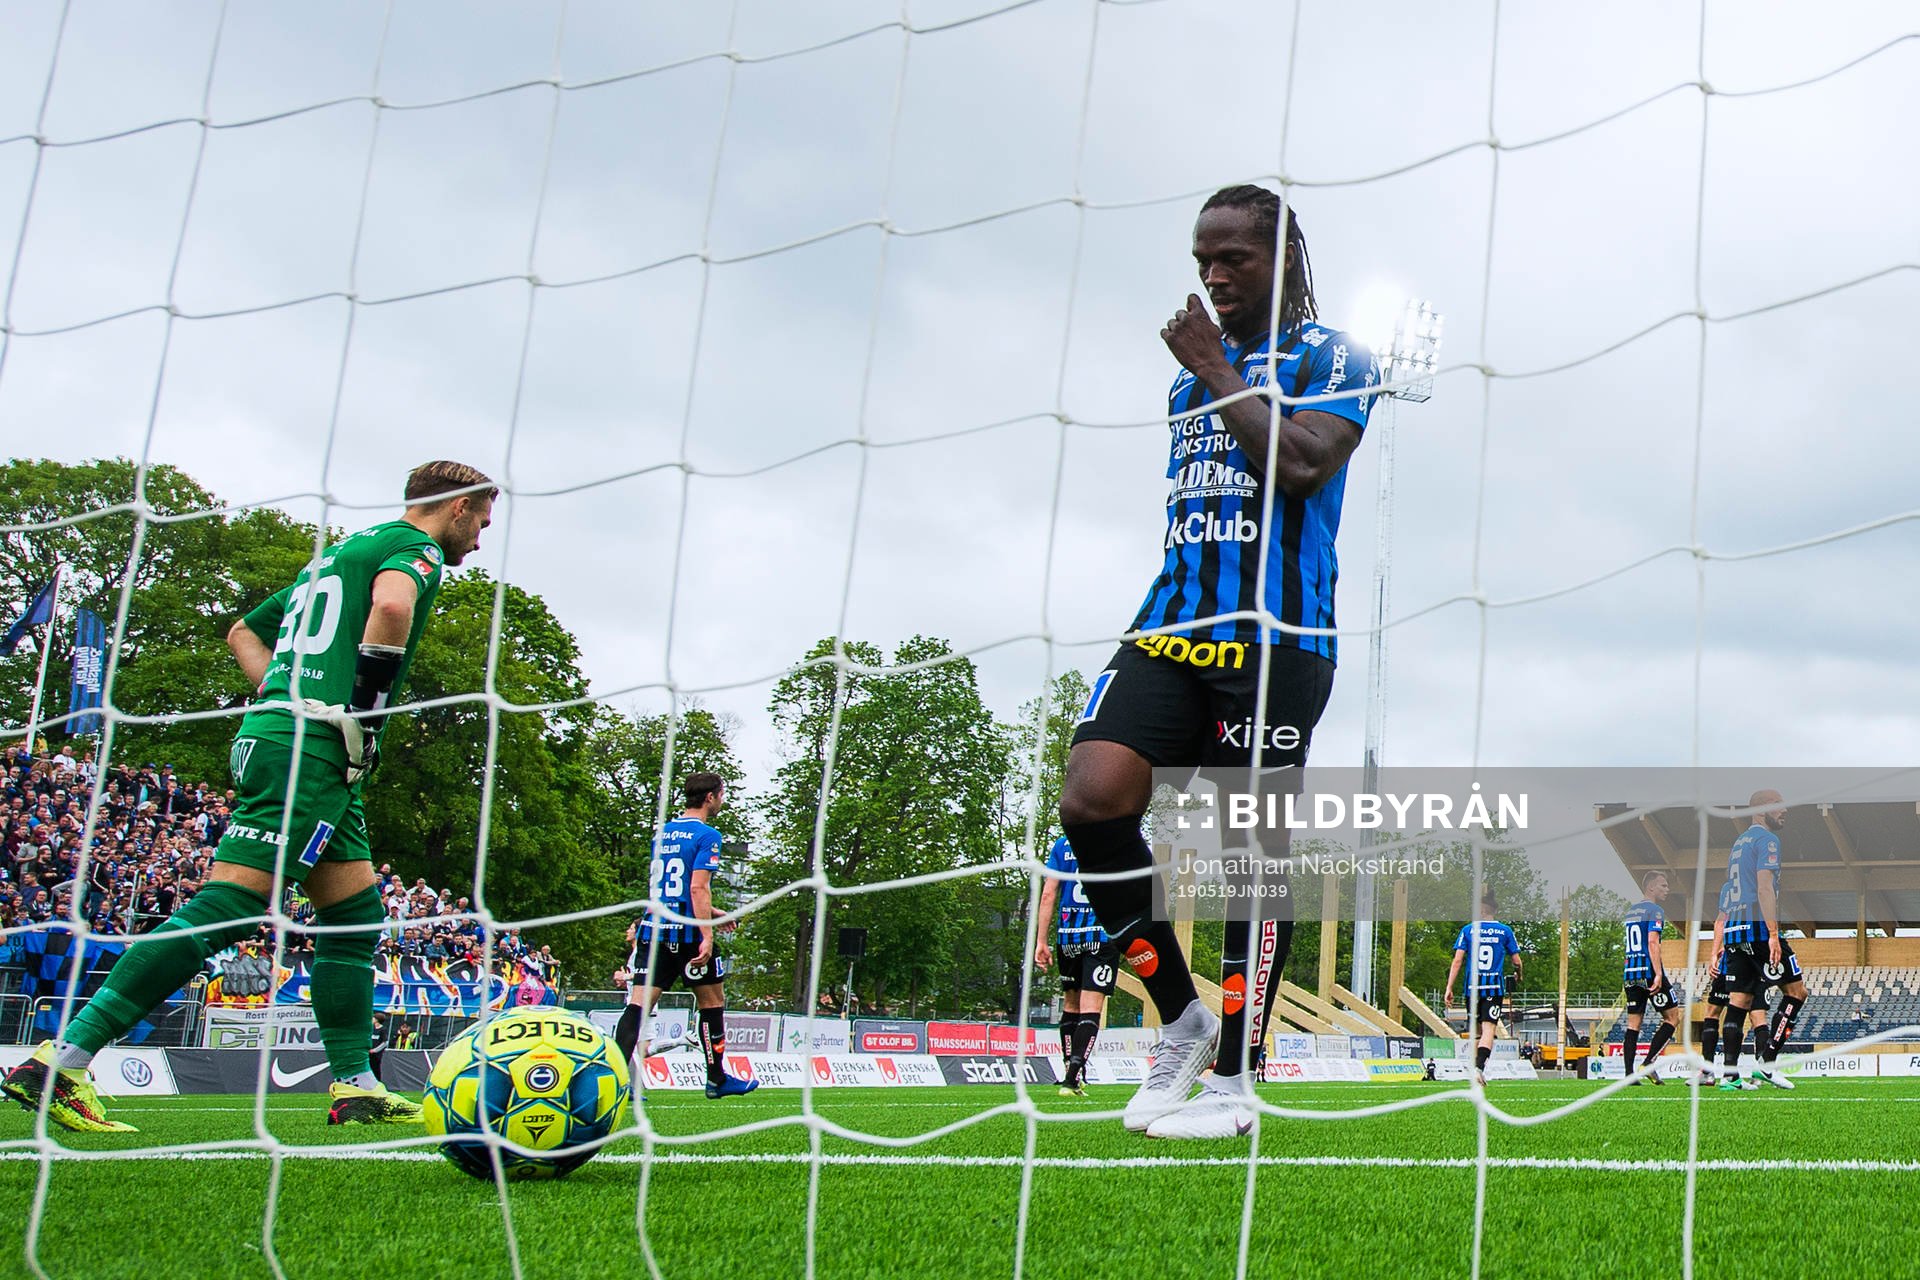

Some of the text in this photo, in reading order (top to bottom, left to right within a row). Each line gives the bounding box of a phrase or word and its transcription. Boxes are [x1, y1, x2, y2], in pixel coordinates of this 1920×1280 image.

[273, 574, 343, 661] 30
[649, 857, 685, 898] 23
[1625, 923, 1643, 953] 10
[1253, 920, 1277, 1008] MOTOR
[1478, 945, 1494, 971] 9
[276, 1010, 313, 1019] specialist
[490, 1021, 594, 1046] SELECT
[866, 1037, 915, 1046] ST OLOF BIL
[928, 1037, 987, 1051] TRANSSCHAKT
[1036, 1042, 1063, 1055] VIKIN
[672, 1063, 707, 1074] SVENS
[755, 1062, 802, 1073] SVENSKA
[832, 1062, 875, 1073] SVENSKA
[898, 1062, 938, 1072] SVENSKA
[1805, 1057, 1861, 1070] mella el
[961, 1057, 1039, 1083] stadium
[679, 1076, 706, 1087] SPEL
[758, 1074, 785, 1086] SPEL
[837, 1074, 860, 1085] SPEL
[903, 1074, 925, 1084] SPEL
[522, 1114, 555, 1124] SELECT
